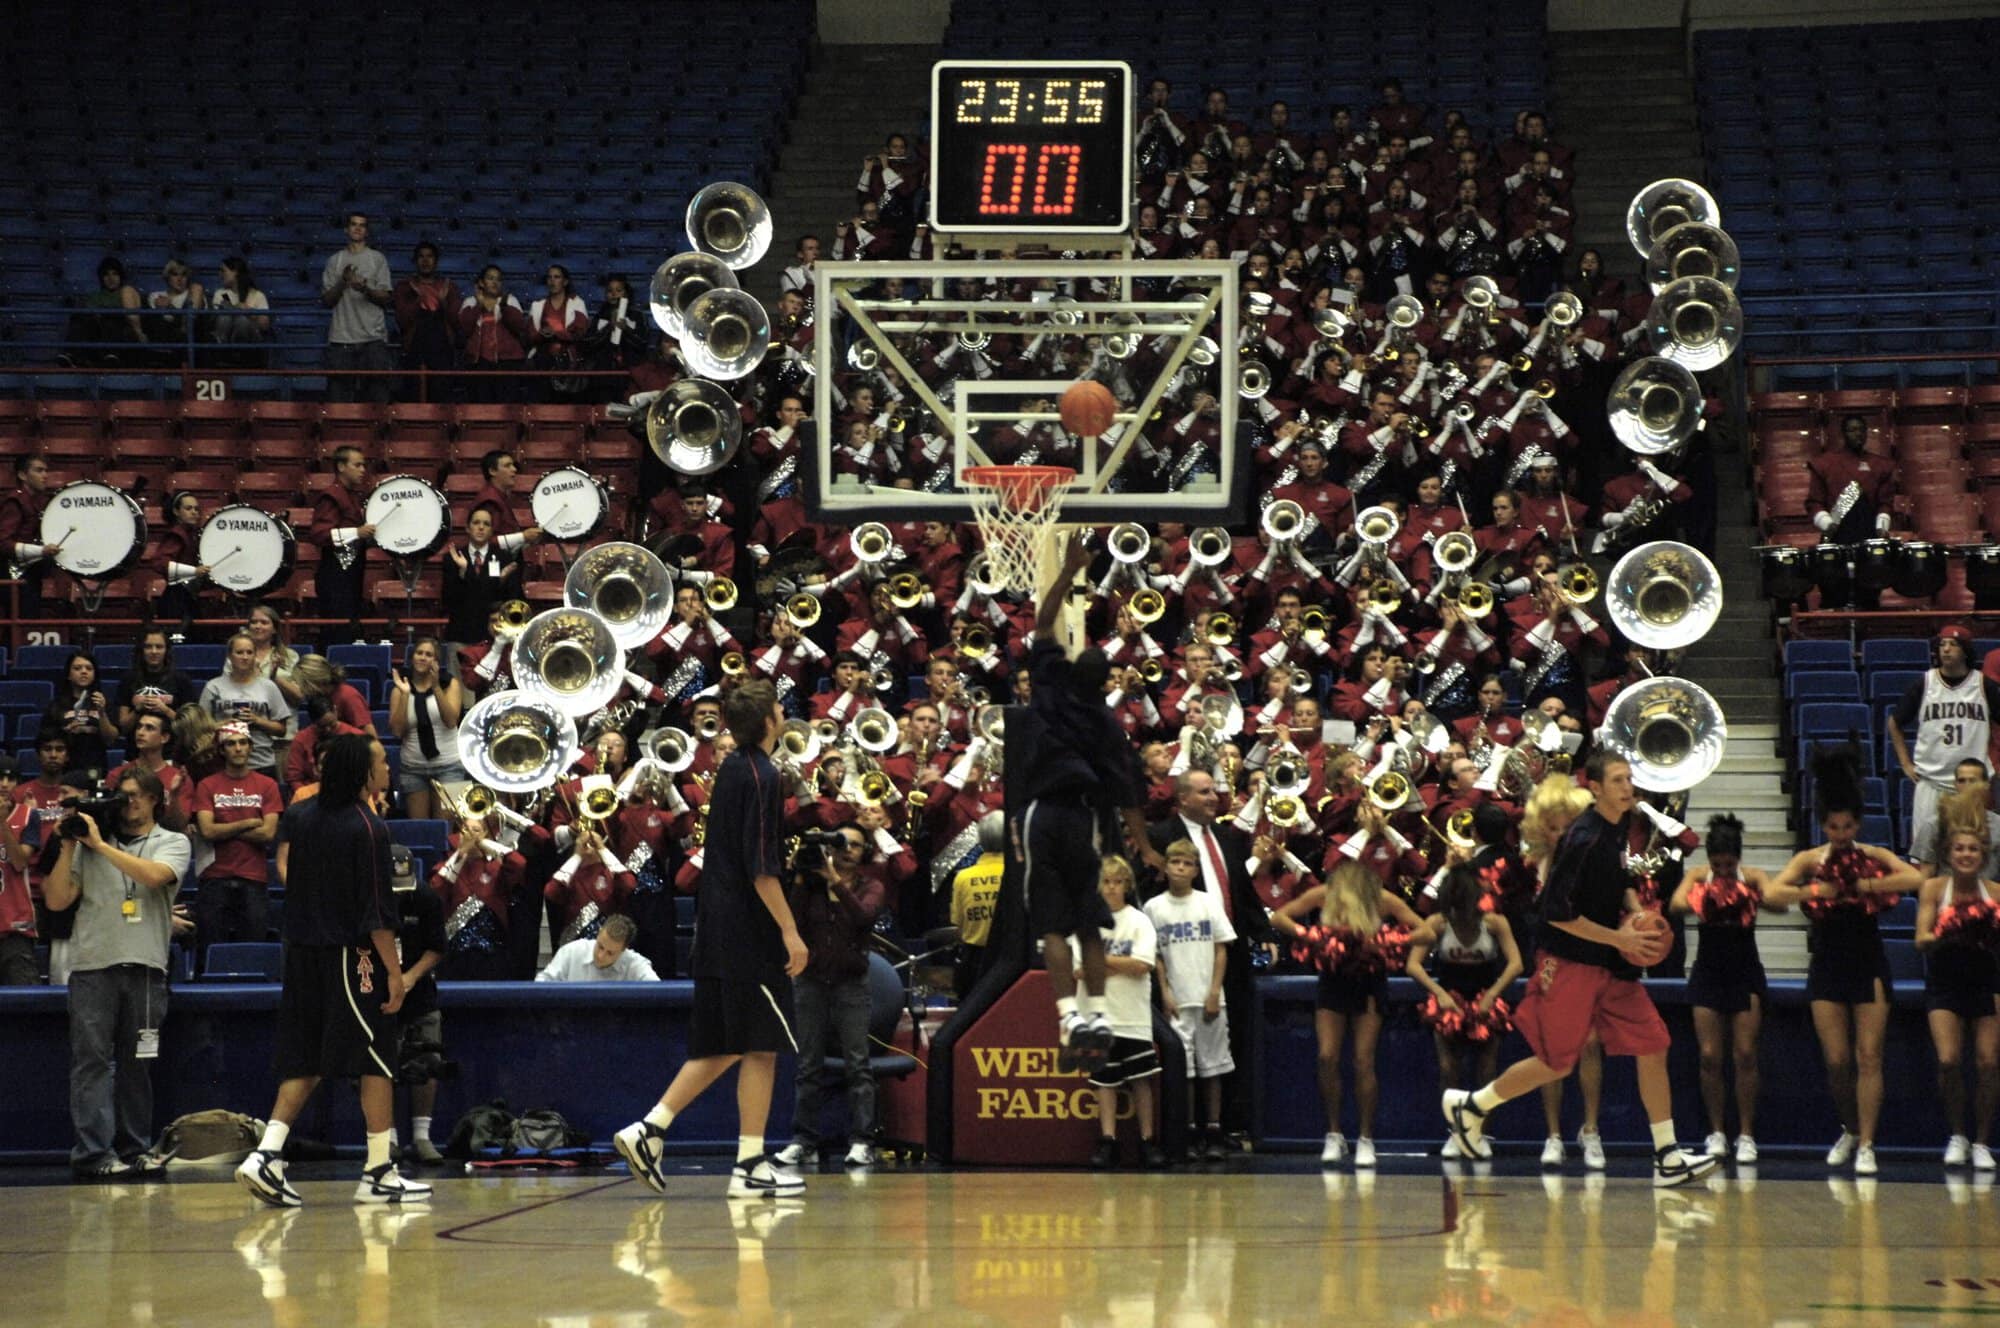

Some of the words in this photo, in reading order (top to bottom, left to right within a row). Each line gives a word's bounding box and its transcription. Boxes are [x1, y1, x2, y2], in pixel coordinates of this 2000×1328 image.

[956, 80, 1106, 123] 23:55
[979, 144, 1081, 215] 00
[196, 380, 225, 401] 20
[390, 489, 424, 501] YAMAHA
[551, 480, 584, 494] YAMAHA
[73, 496, 114, 508] YAMAHA
[229, 519, 269, 532] YAMAHA
[27, 631, 61, 647] 20
[1923, 702, 1986, 722] ARIZONA
[1943, 724, 1963, 746] 31
[970, 875, 1000, 887] EVE
[973, 891, 999, 901] STA
[971, 1047, 1091, 1078] WEL
